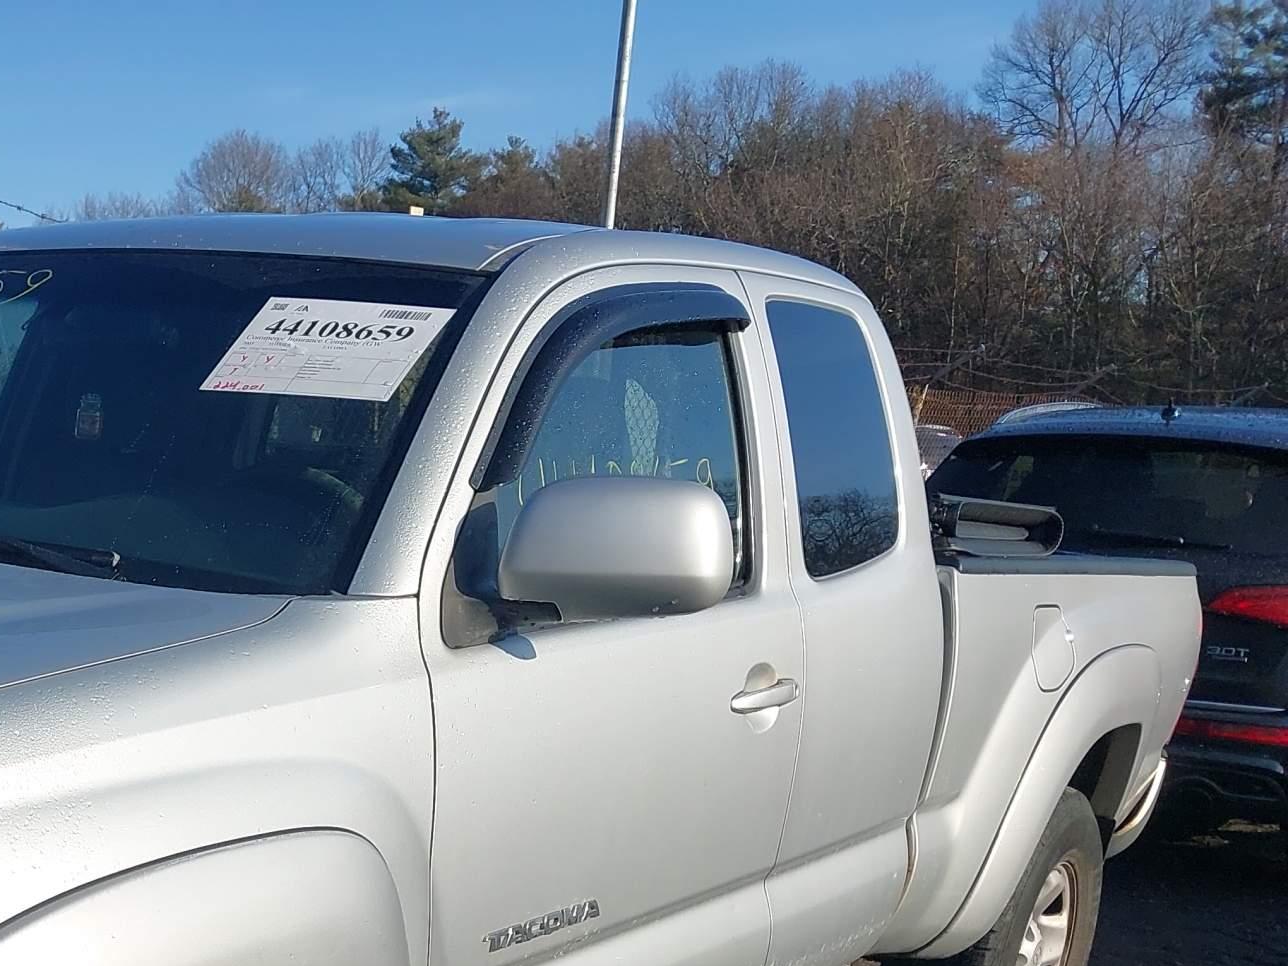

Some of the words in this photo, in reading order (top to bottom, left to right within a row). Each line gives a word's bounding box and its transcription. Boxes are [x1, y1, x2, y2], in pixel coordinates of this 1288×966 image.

[245, 334, 286, 345] Commerce
[287, 335, 324, 345] Insurance
[324, 337, 362, 348] Company
[264, 317, 416, 344] 44108659
[483, 899, 601, 953] TACOMA
